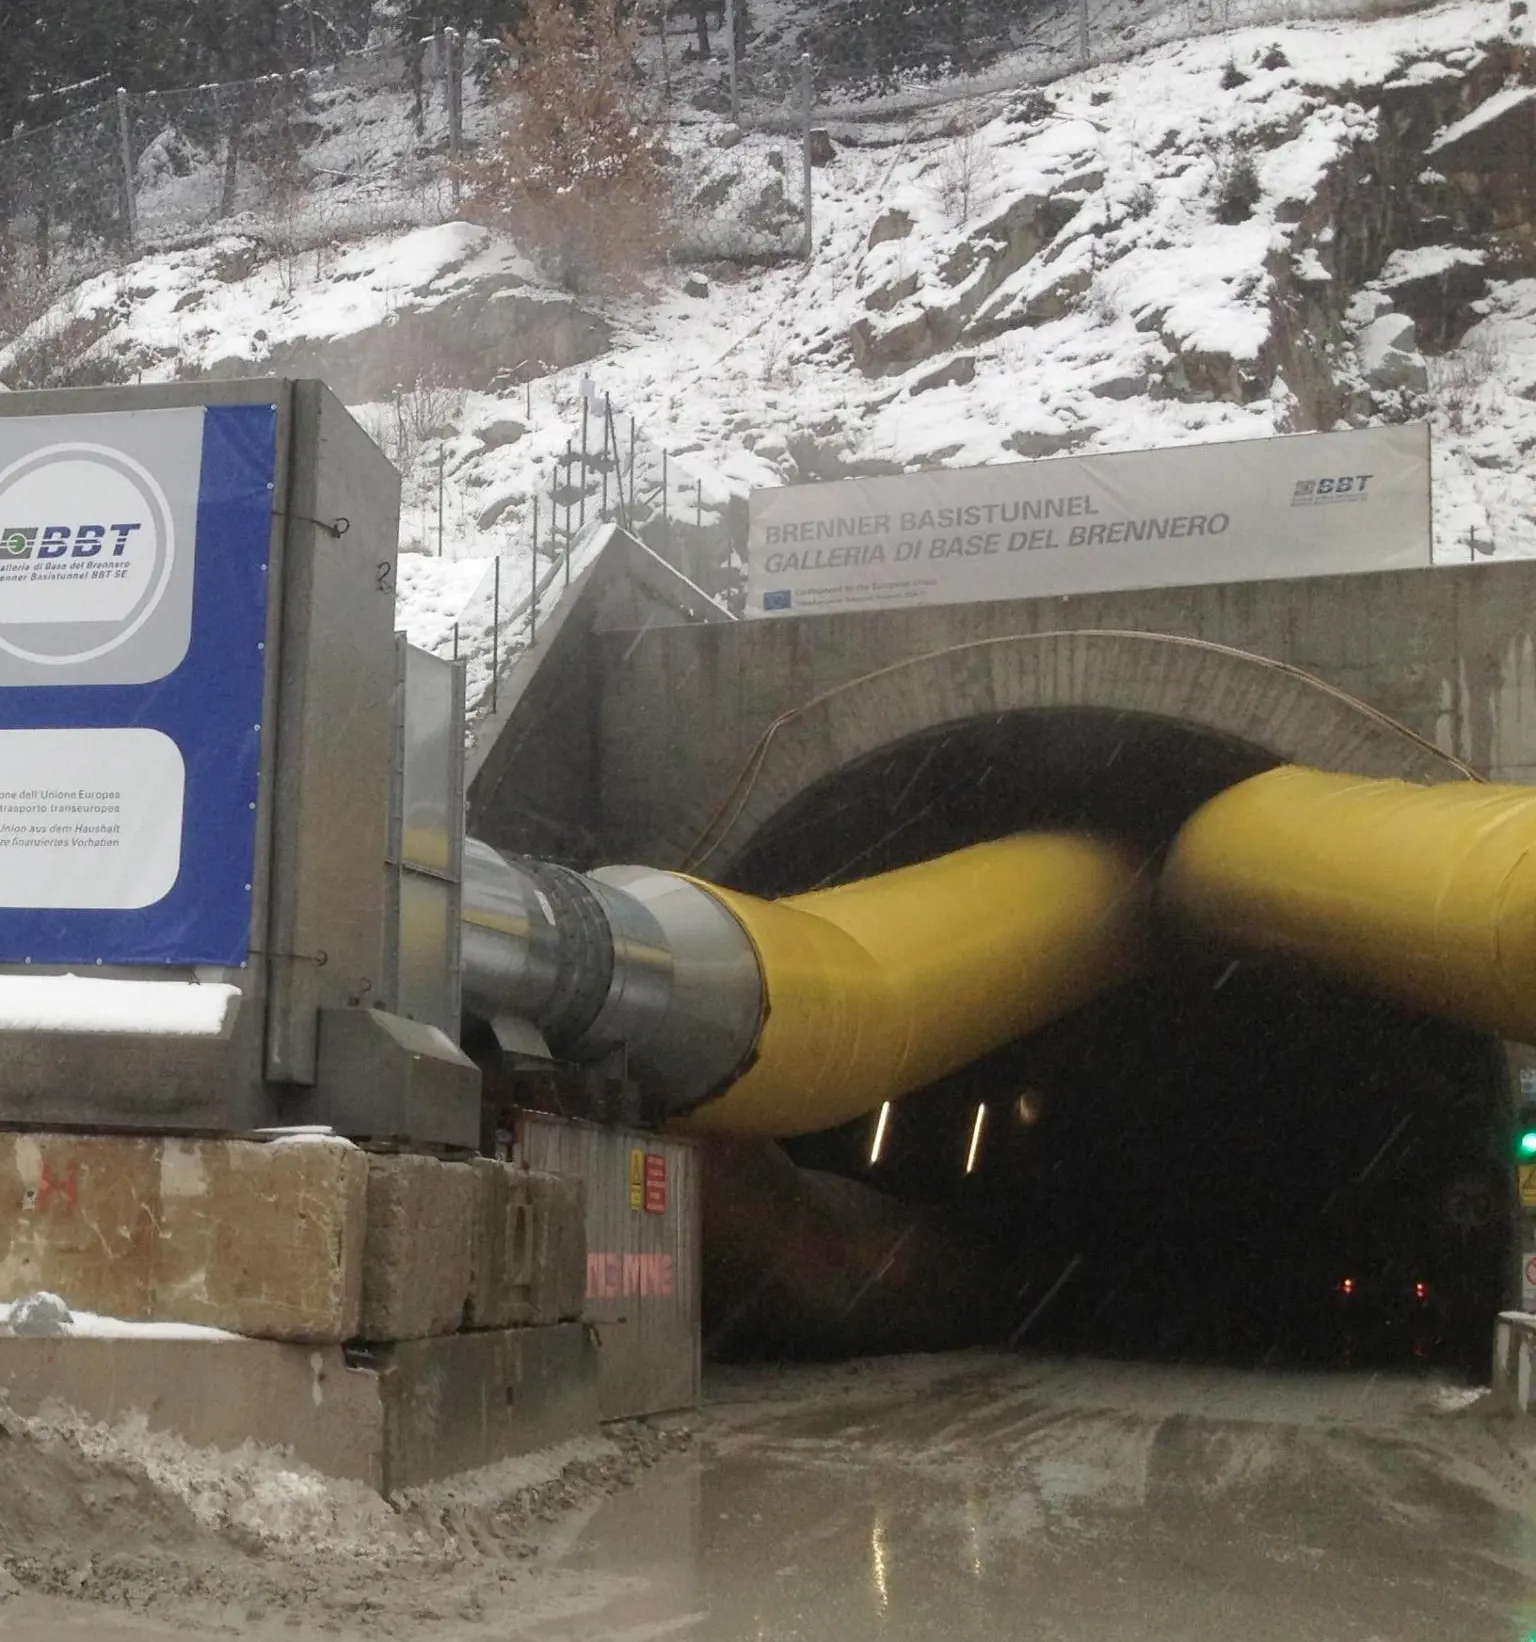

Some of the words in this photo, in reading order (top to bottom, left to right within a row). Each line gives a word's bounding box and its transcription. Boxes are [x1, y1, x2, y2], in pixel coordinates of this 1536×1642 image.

[37, 523, 141, 558] BBT
[764, 542, 885, 574] GALLERIA
[894, 539, 923, 562] DI
[929, 533, 1001, 559] BASE
[1008, 529, 1059, 552] DEL
[1068, 513, 1230, 547] BRENNERO
[765, 515, 891, 545] BRENNER
[901, 495, 1098, 531] BASISTUNNEL
